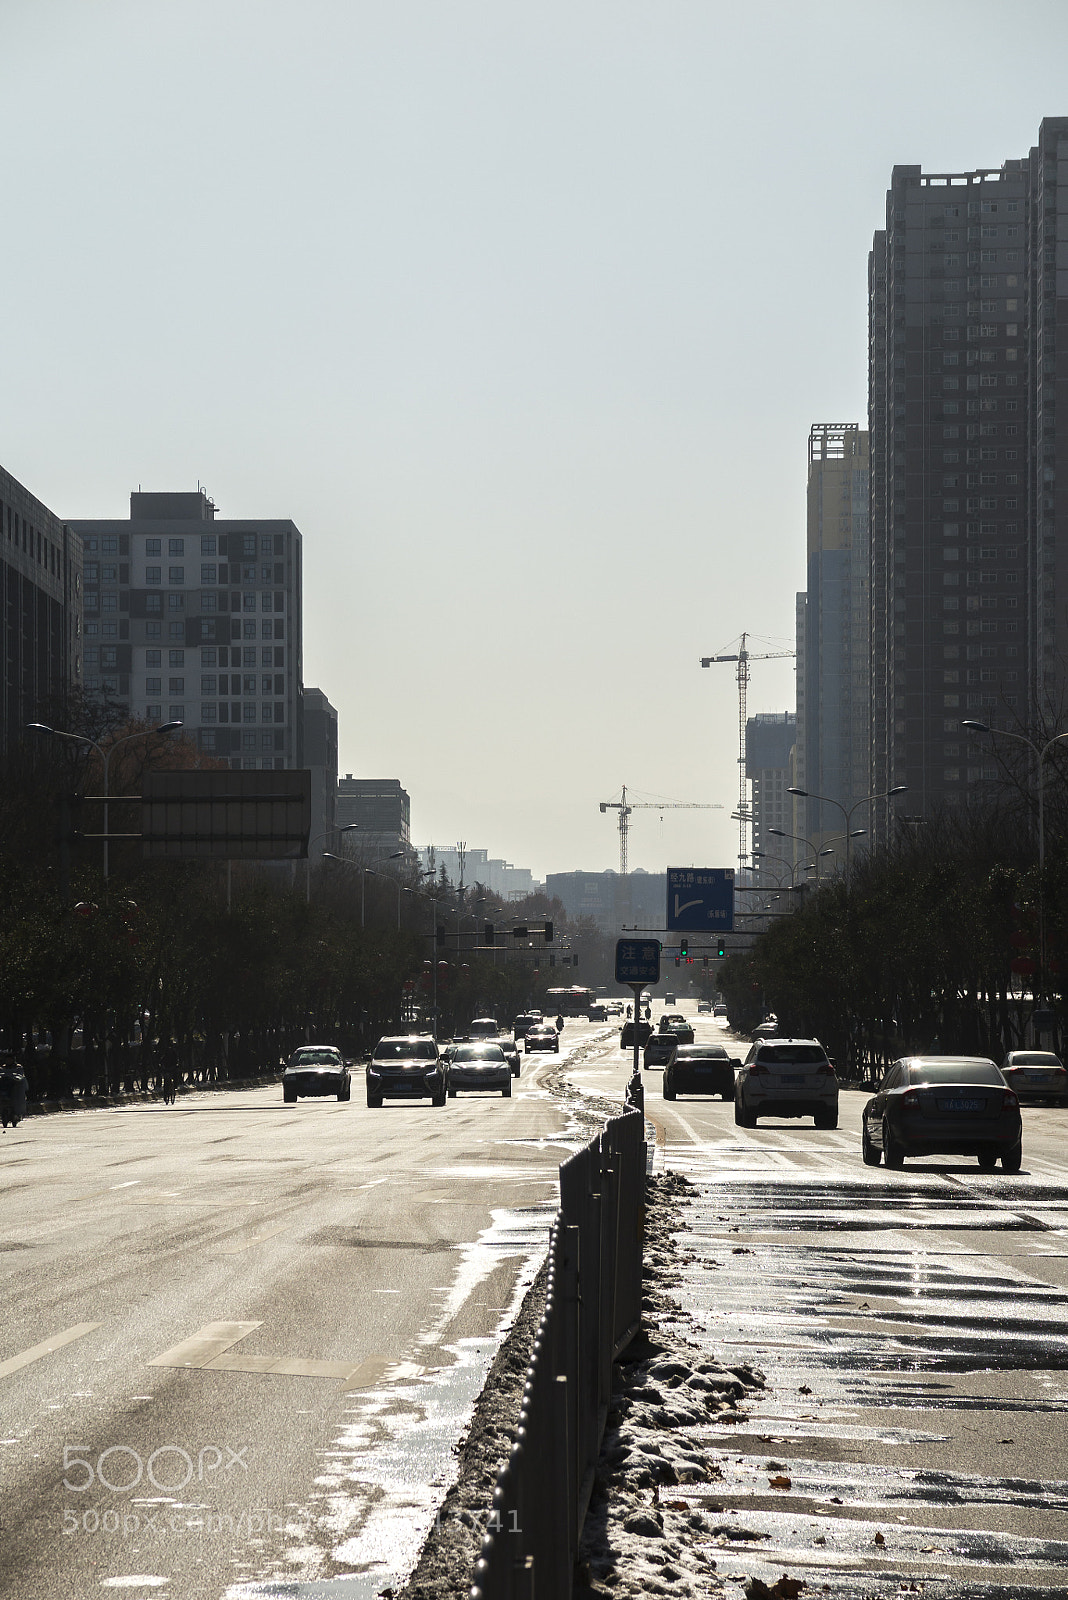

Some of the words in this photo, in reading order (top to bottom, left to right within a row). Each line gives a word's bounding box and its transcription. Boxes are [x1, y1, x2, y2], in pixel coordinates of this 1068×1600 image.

[621, 945, 656, 960] 注意
[686, 957, 694, 965] 33
[619, 966, 657, 976] 交通安全
